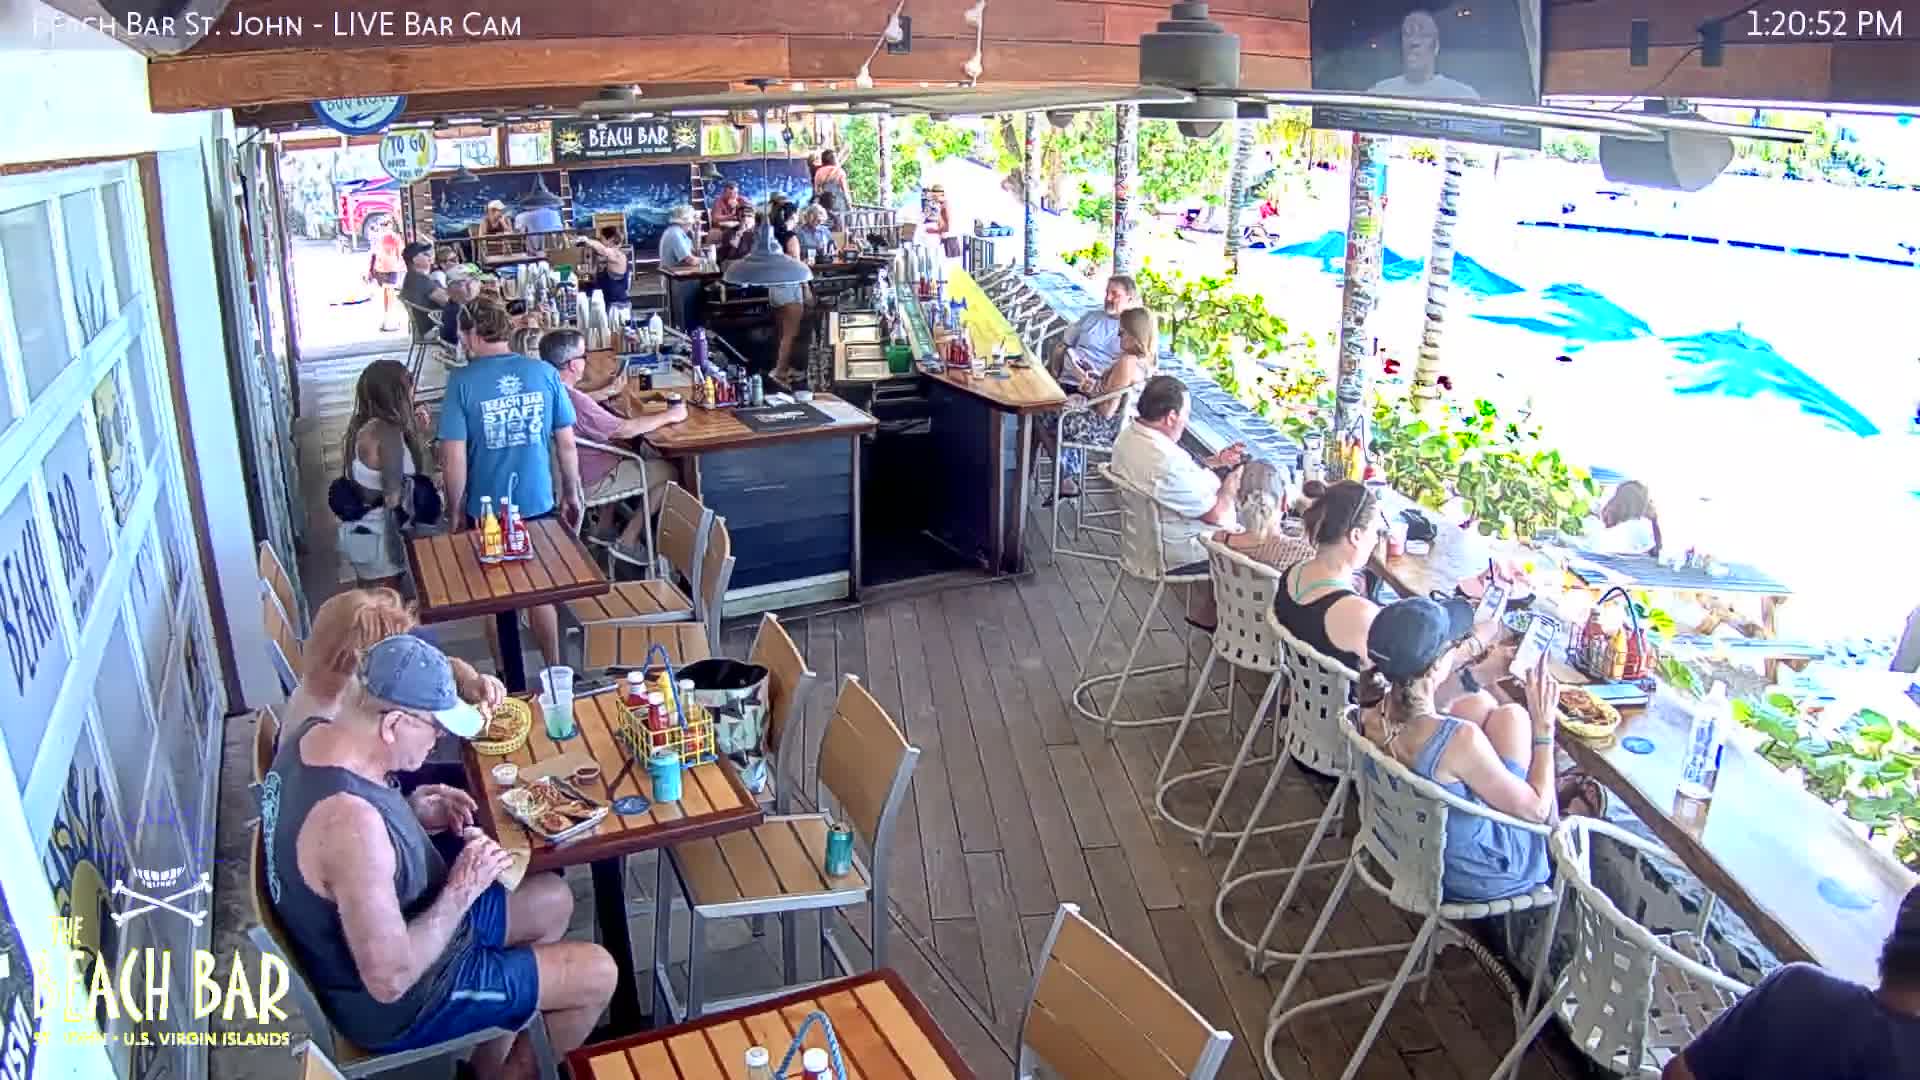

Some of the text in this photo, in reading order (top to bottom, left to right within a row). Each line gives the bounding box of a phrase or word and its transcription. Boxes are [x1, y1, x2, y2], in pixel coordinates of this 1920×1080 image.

[387, 132, 426, 156] TO GO
[588, 125, 669, 148] BEACH BAR
[483, 405, 544, 425] STAFF
